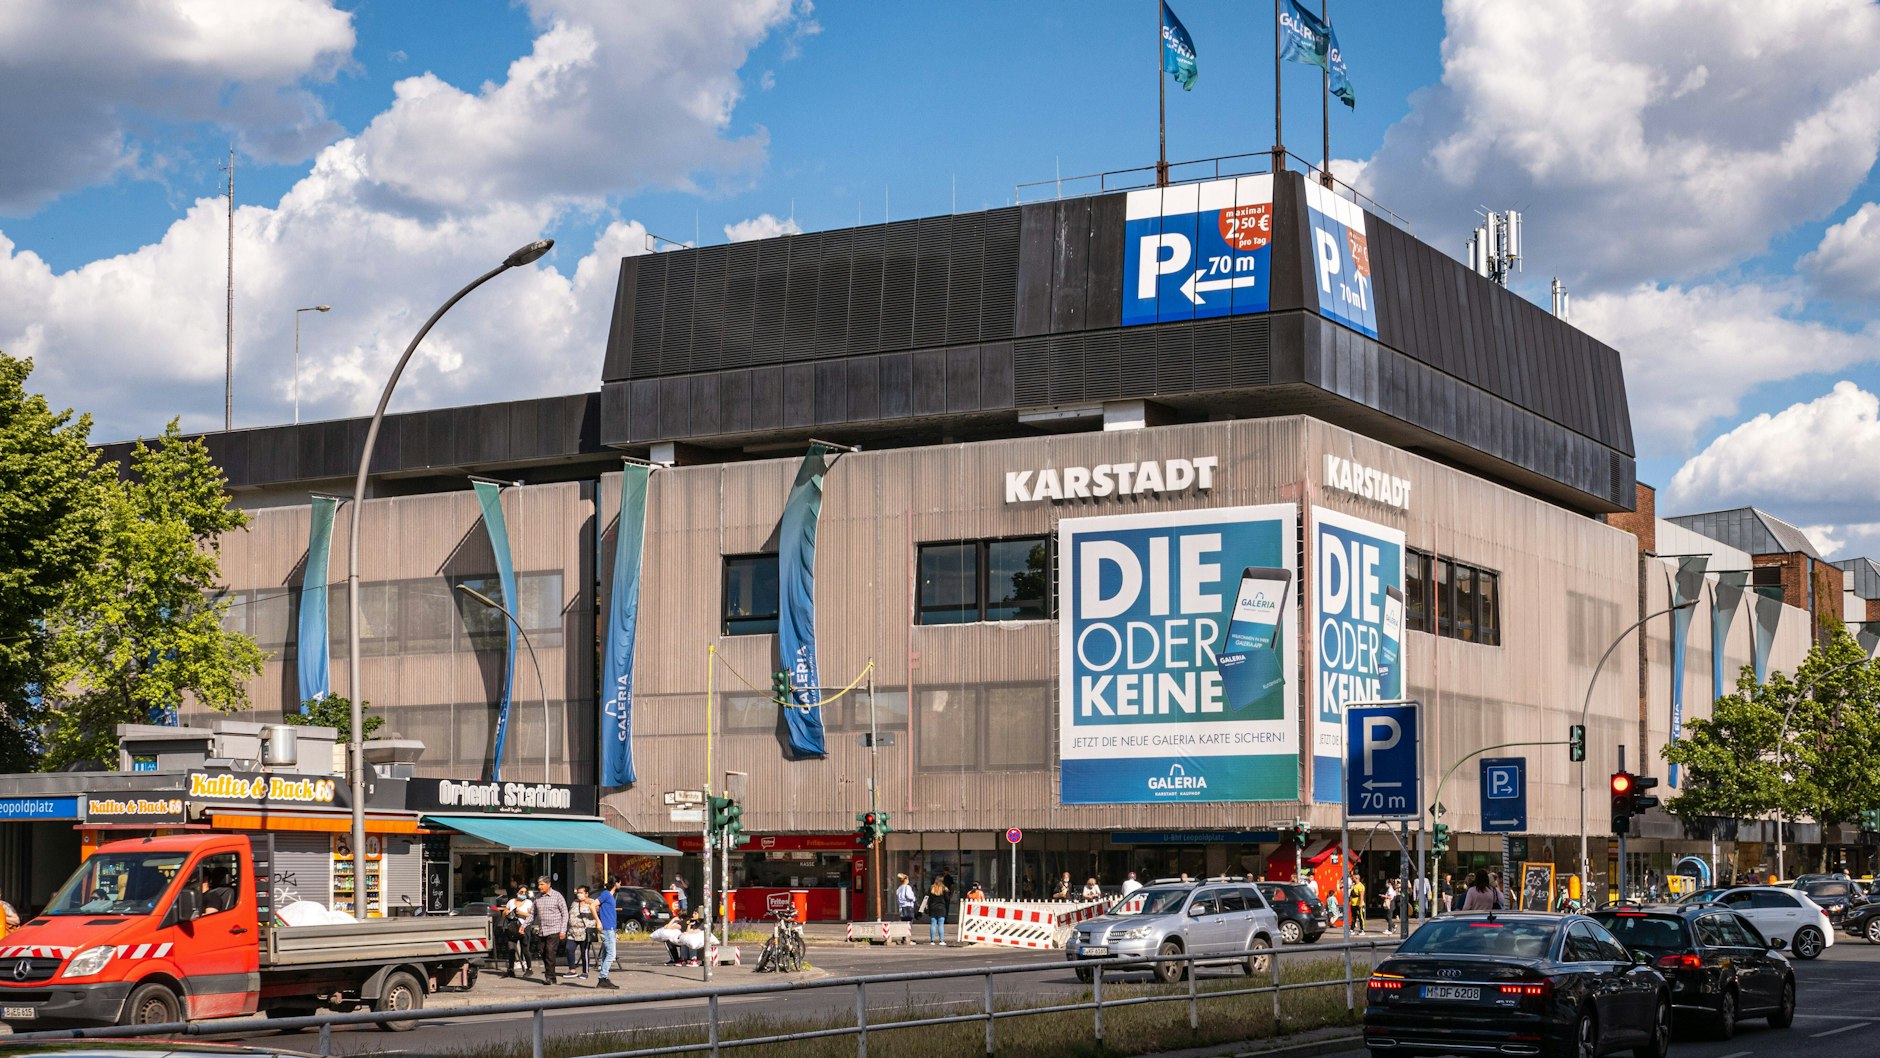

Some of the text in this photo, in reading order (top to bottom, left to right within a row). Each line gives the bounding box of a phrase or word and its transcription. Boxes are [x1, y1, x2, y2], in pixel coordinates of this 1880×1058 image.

[1226, 205, 1265, 218] maximal
[1257, 214, 1270, 232] €
[1239, 236, 1267, 249] pro Tag
[1138, 232, 1192, 300] P
[1209, 255, 1254, 275] 70 m
[1315, 226, 1340, 294] P
[1340, 283, 1351, 304] 70
[1005, 456, 1218, 503] KARSTADT
[1322, 453, 1411, 510] KARSTADT
[1080, 533, 1223, 620] DIE
[1321, 532, 1380, 624] DIE
[1241, 598, 1275, 609] GALERIA
[1077, 618, 1219, 672] ODER
[1321, 618, 1379, 675] ODER
[1220, 655, 1246, 664] GALERIA
[1081, 671, 1224, 716] KEINE
[618, 674, 628, 741] GALERIA
[1073, 731, 1285, 748] JETZT DIE NEUE GALERIA KARTE SICHERN!
[1362, 716, 1402, 776] P
[190, 773, 250, 797] Kaffee
[251, 776, 267, 798] &
[268, 777, 314, 801] Back
[1148, 776, 1207, 789] GALERIA
[1493, 771, 1510, 794] P
[439, 780, 570, 809] Orient Station
[1361, 793, 1405, 809] 70 m
[90, 800, 125, 814] Kaffee
[127, 801, 137, 814] &
[138, 800, 168, 814] Back
[1184, 833, 1224, 842] Leopoldplatz
[1427, 986, 1479, 999] M DF 6208
